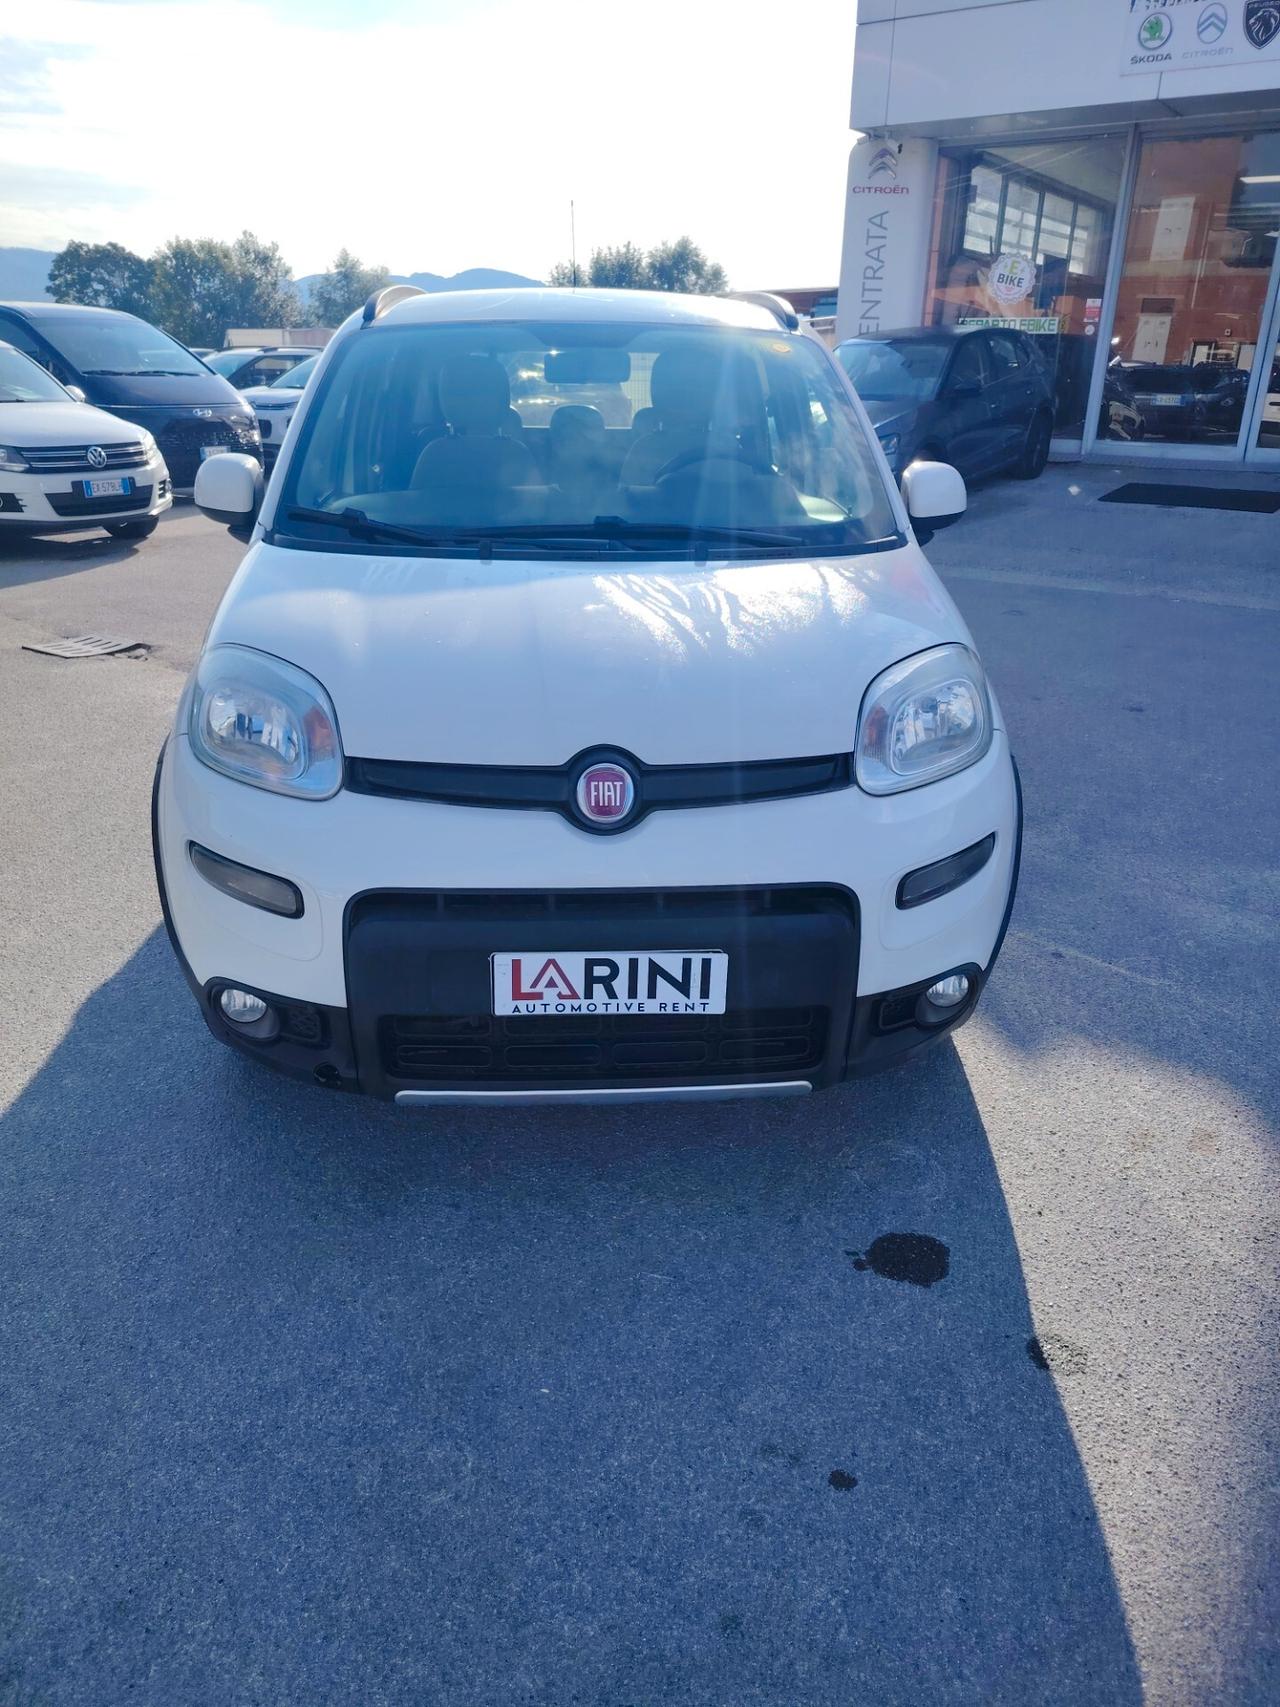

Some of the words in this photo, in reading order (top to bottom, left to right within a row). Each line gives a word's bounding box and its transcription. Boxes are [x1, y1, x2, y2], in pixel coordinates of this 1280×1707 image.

[1130, 52, 1172, 65] ŠKODA
[1182, 47, 1234, 59] CITROËN
[852, 184, 910, 195] CITROËN
[858, 210, 889, 336] ENTRATA
[1008, 260, 1019, 275] E
[997, 273, 1025, 288] BIKE
[590, 781, 624, 807] FIAT
[511, 957, 712, 1001] LARINI
[512, 1002, 645, 1014] AUTOMOTIVE
[659, 1002, 710, 1012] RENT
